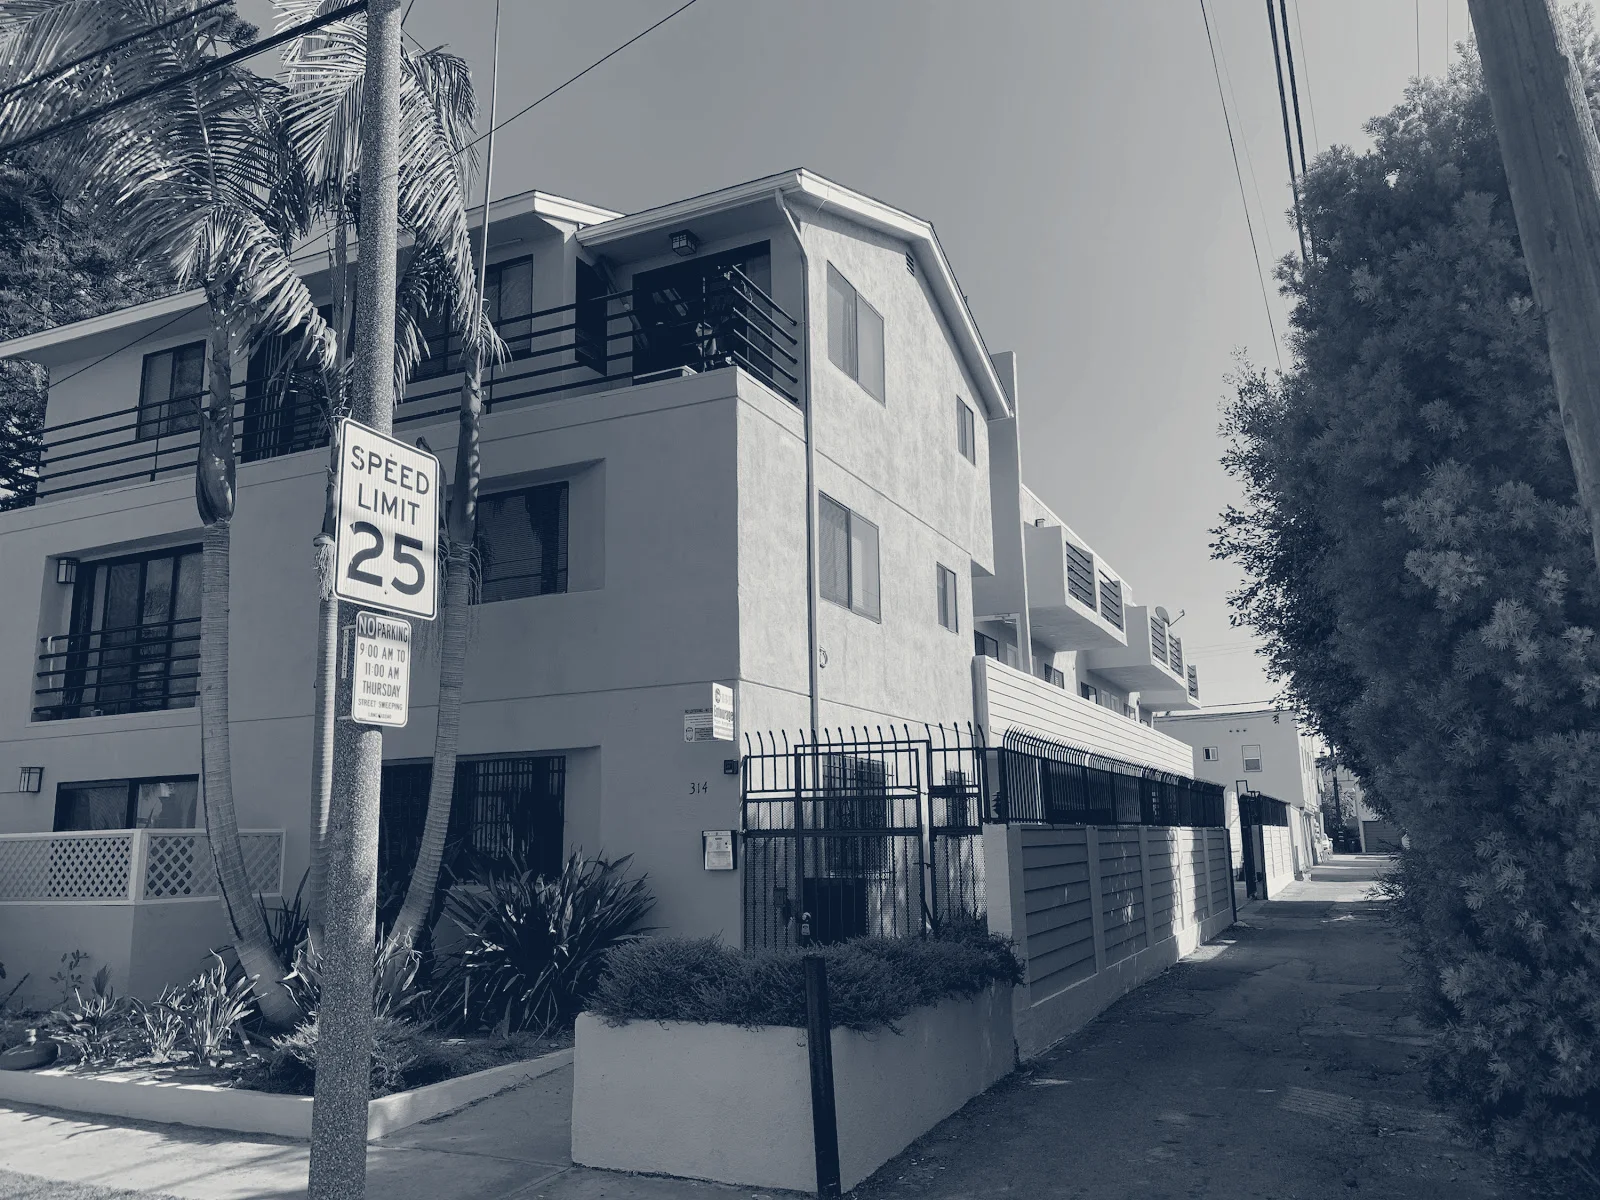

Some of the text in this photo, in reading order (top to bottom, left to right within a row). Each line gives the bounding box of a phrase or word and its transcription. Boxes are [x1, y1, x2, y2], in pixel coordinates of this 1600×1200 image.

[351, 445, 430, 495] SPEED
[358, 483, 420, 525] LIMIT
[347, 521, 426, 596] 25
[358, 616, 408, 643] NO PARKING
[359, 642, 406, 663] 9:00 AM TO
[365, 662, 400, 680] 11:00 AM
[362, 680, 401, 698] THURSDAY
[357, 698, 403, 711] STREET SWEEPING
[690, 782, 708, 794] 314
